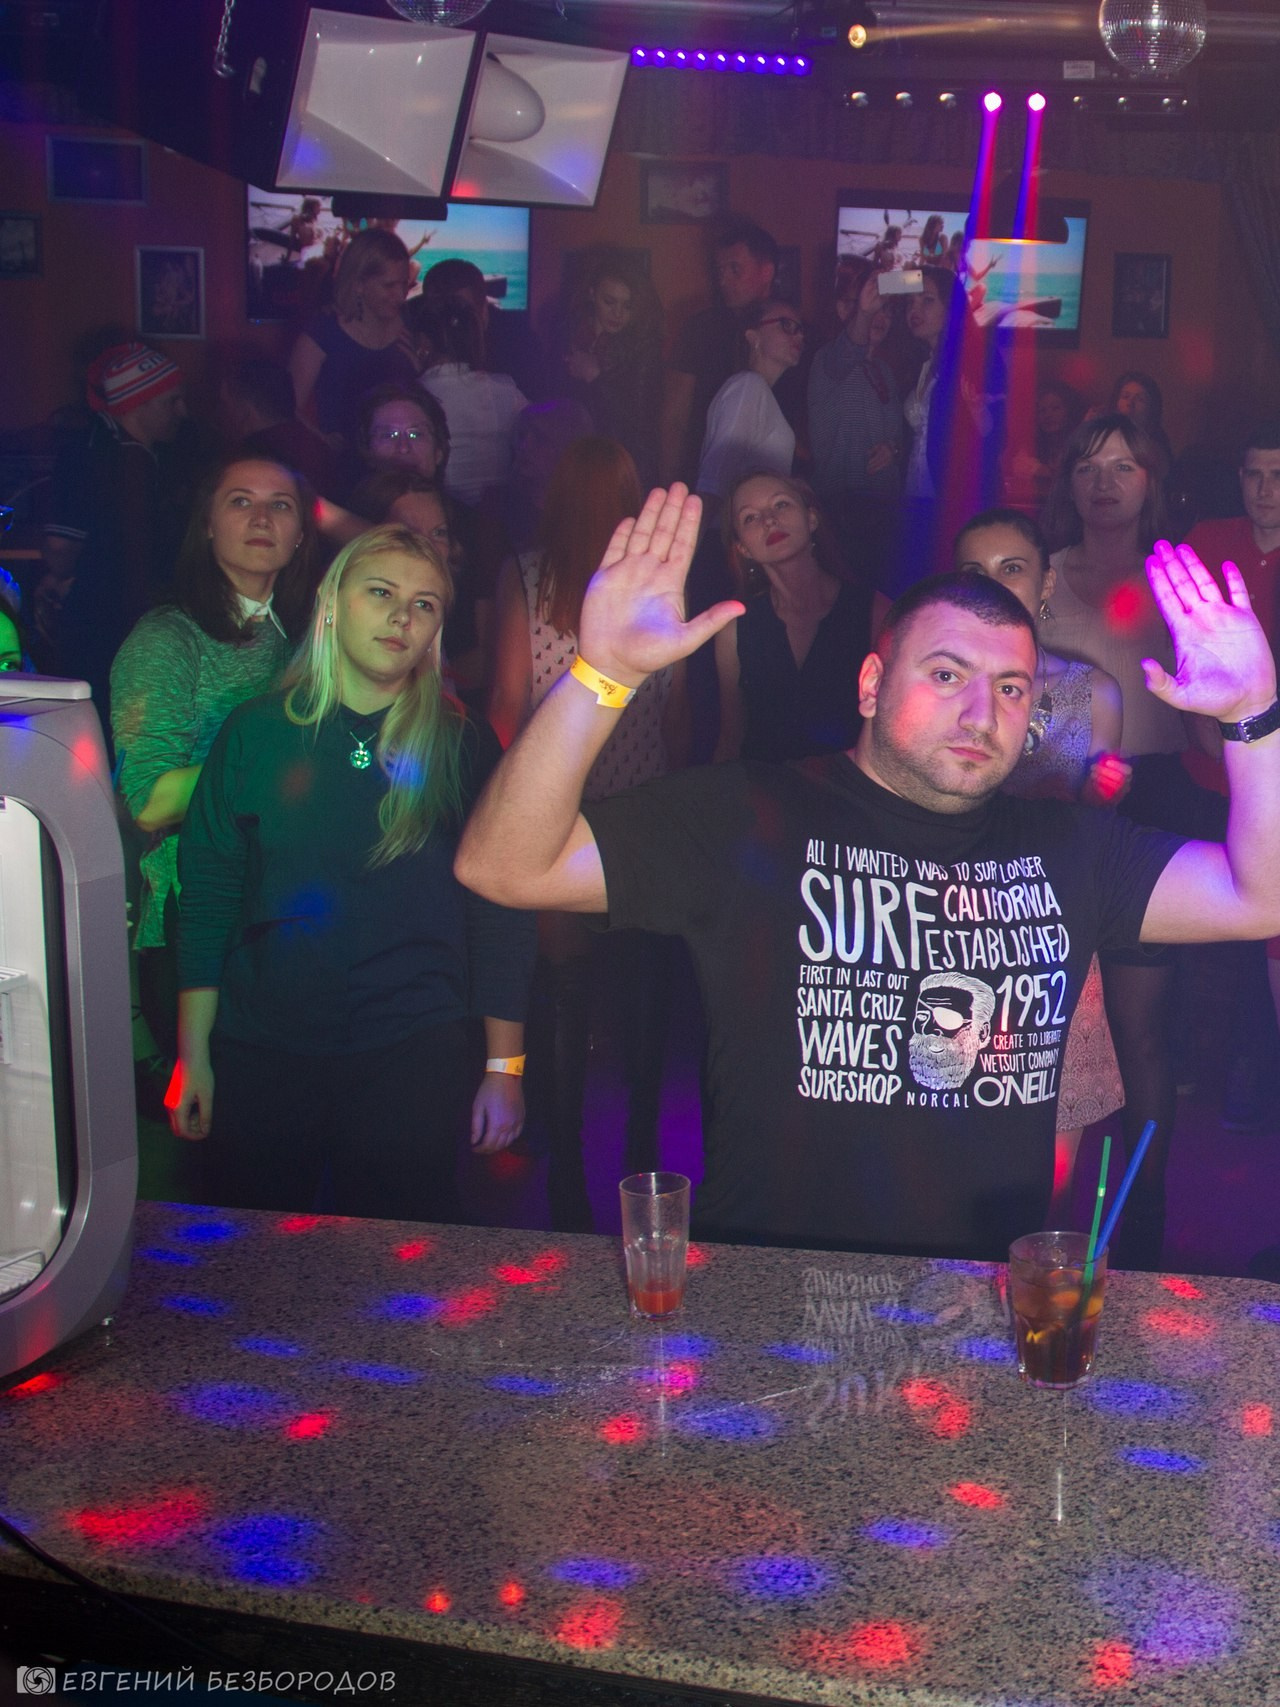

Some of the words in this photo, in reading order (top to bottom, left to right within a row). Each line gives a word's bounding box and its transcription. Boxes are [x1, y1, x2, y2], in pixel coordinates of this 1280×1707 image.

[806, 838, 826, 865] ALL
[835, 844, 839, 868] I
[846, 846, 909, 878] WANTED
[915, 859, 949, 881] WAS
[950, 862, 970, 882] TO
[799, 868, 939, 971] SURF
[943, 882, 1062, 923] CALIFORNIA
[925, 923, 1070, 971] ESTABLISHED
[800, 964, 833, 985] FIRST
[836, 967, 850, 985] IN
[856, 969, 885, 988] LAST
[888, 974, 910, 990] OUT
[797, 987, 853, 1018] SANTA
[860, 991, 906, 1021] CRUZ
[996, 970, 1066, 1032] 1952
[798, 1017, 902, 1071] WAVES
[979, 1053, 1027, 1073] WETSUIT
[1028, 1048, 1059, 1070] COMPANY
[993, 1033, 1024, 1050] CREATE
[1027, 1032, 1039, 1047] TO
[798, 1066, 902, 1105] SURFSHOP
[906, 1092, 970, 1109] NORCAL
